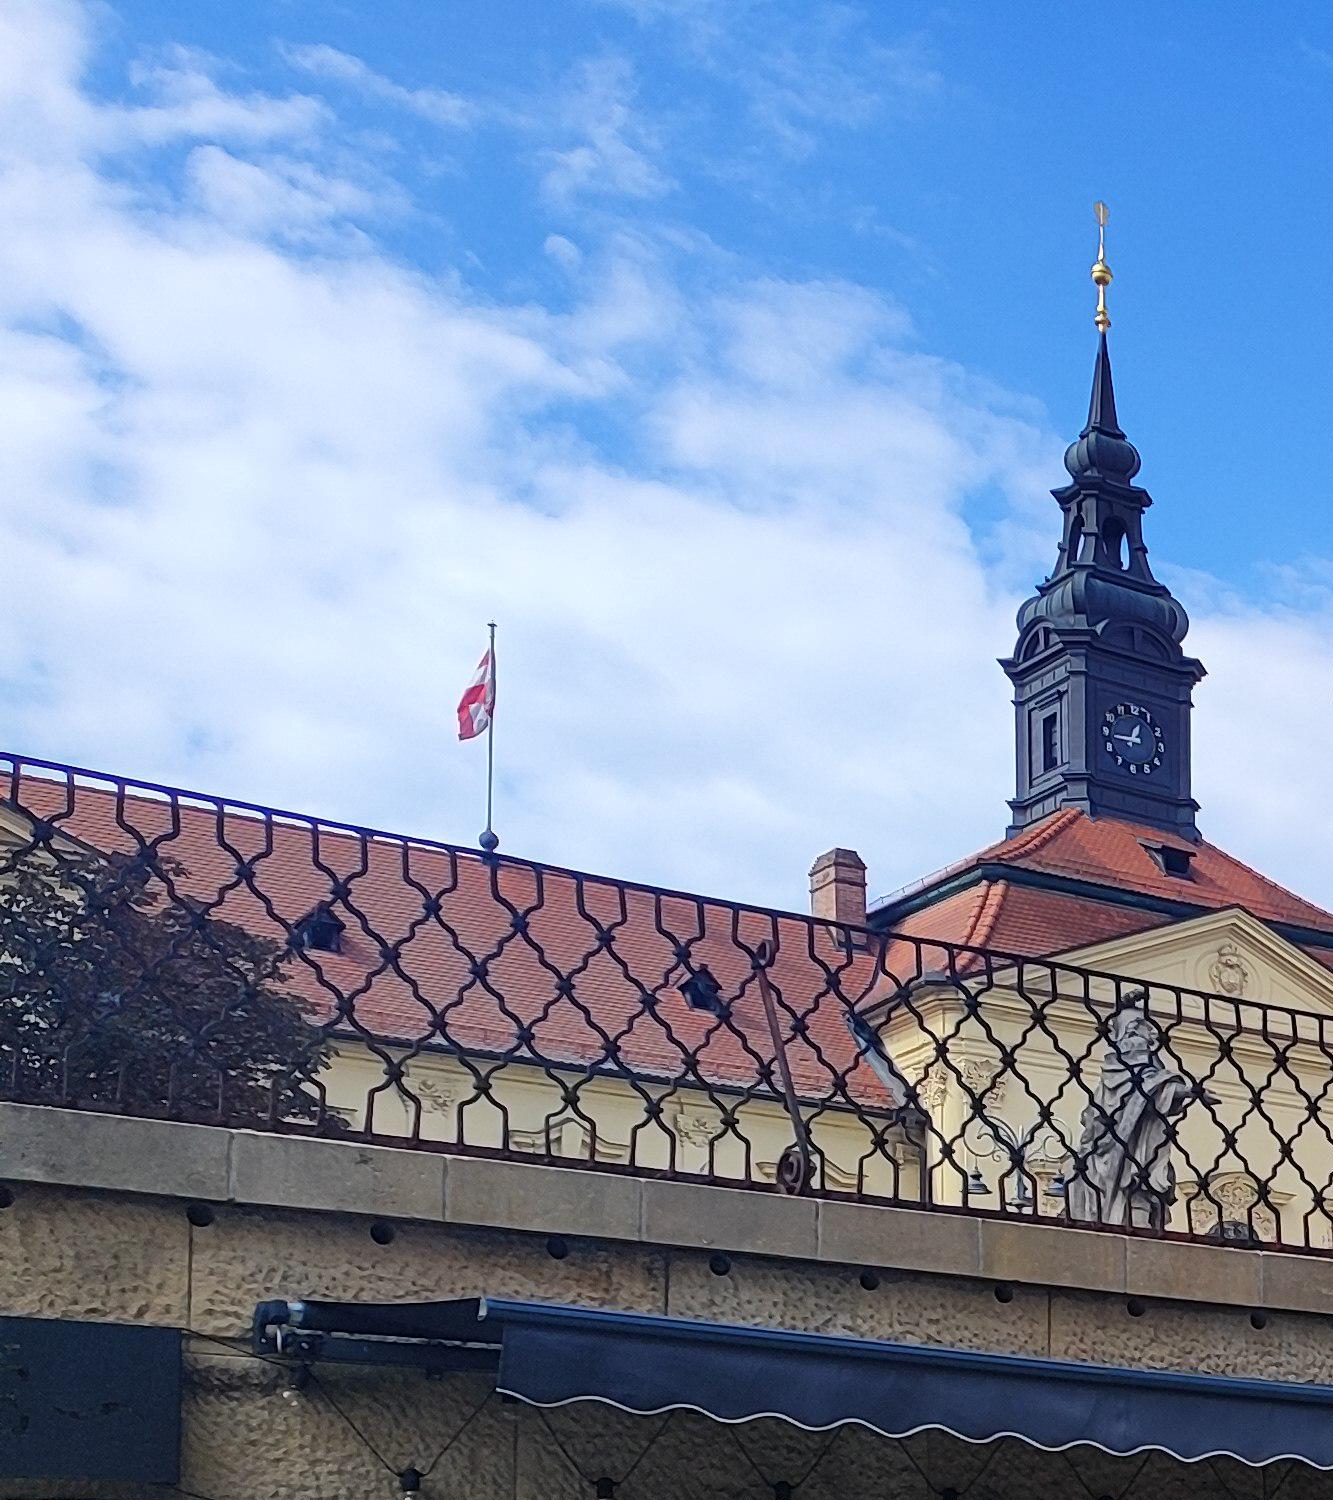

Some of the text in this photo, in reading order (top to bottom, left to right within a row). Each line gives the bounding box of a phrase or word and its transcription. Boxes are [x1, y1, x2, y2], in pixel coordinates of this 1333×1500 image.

[1105, 711, 1116, 723] 10
[1102, 726, 1110, 736] 9
[1154, 726, 1162, 738] 2
